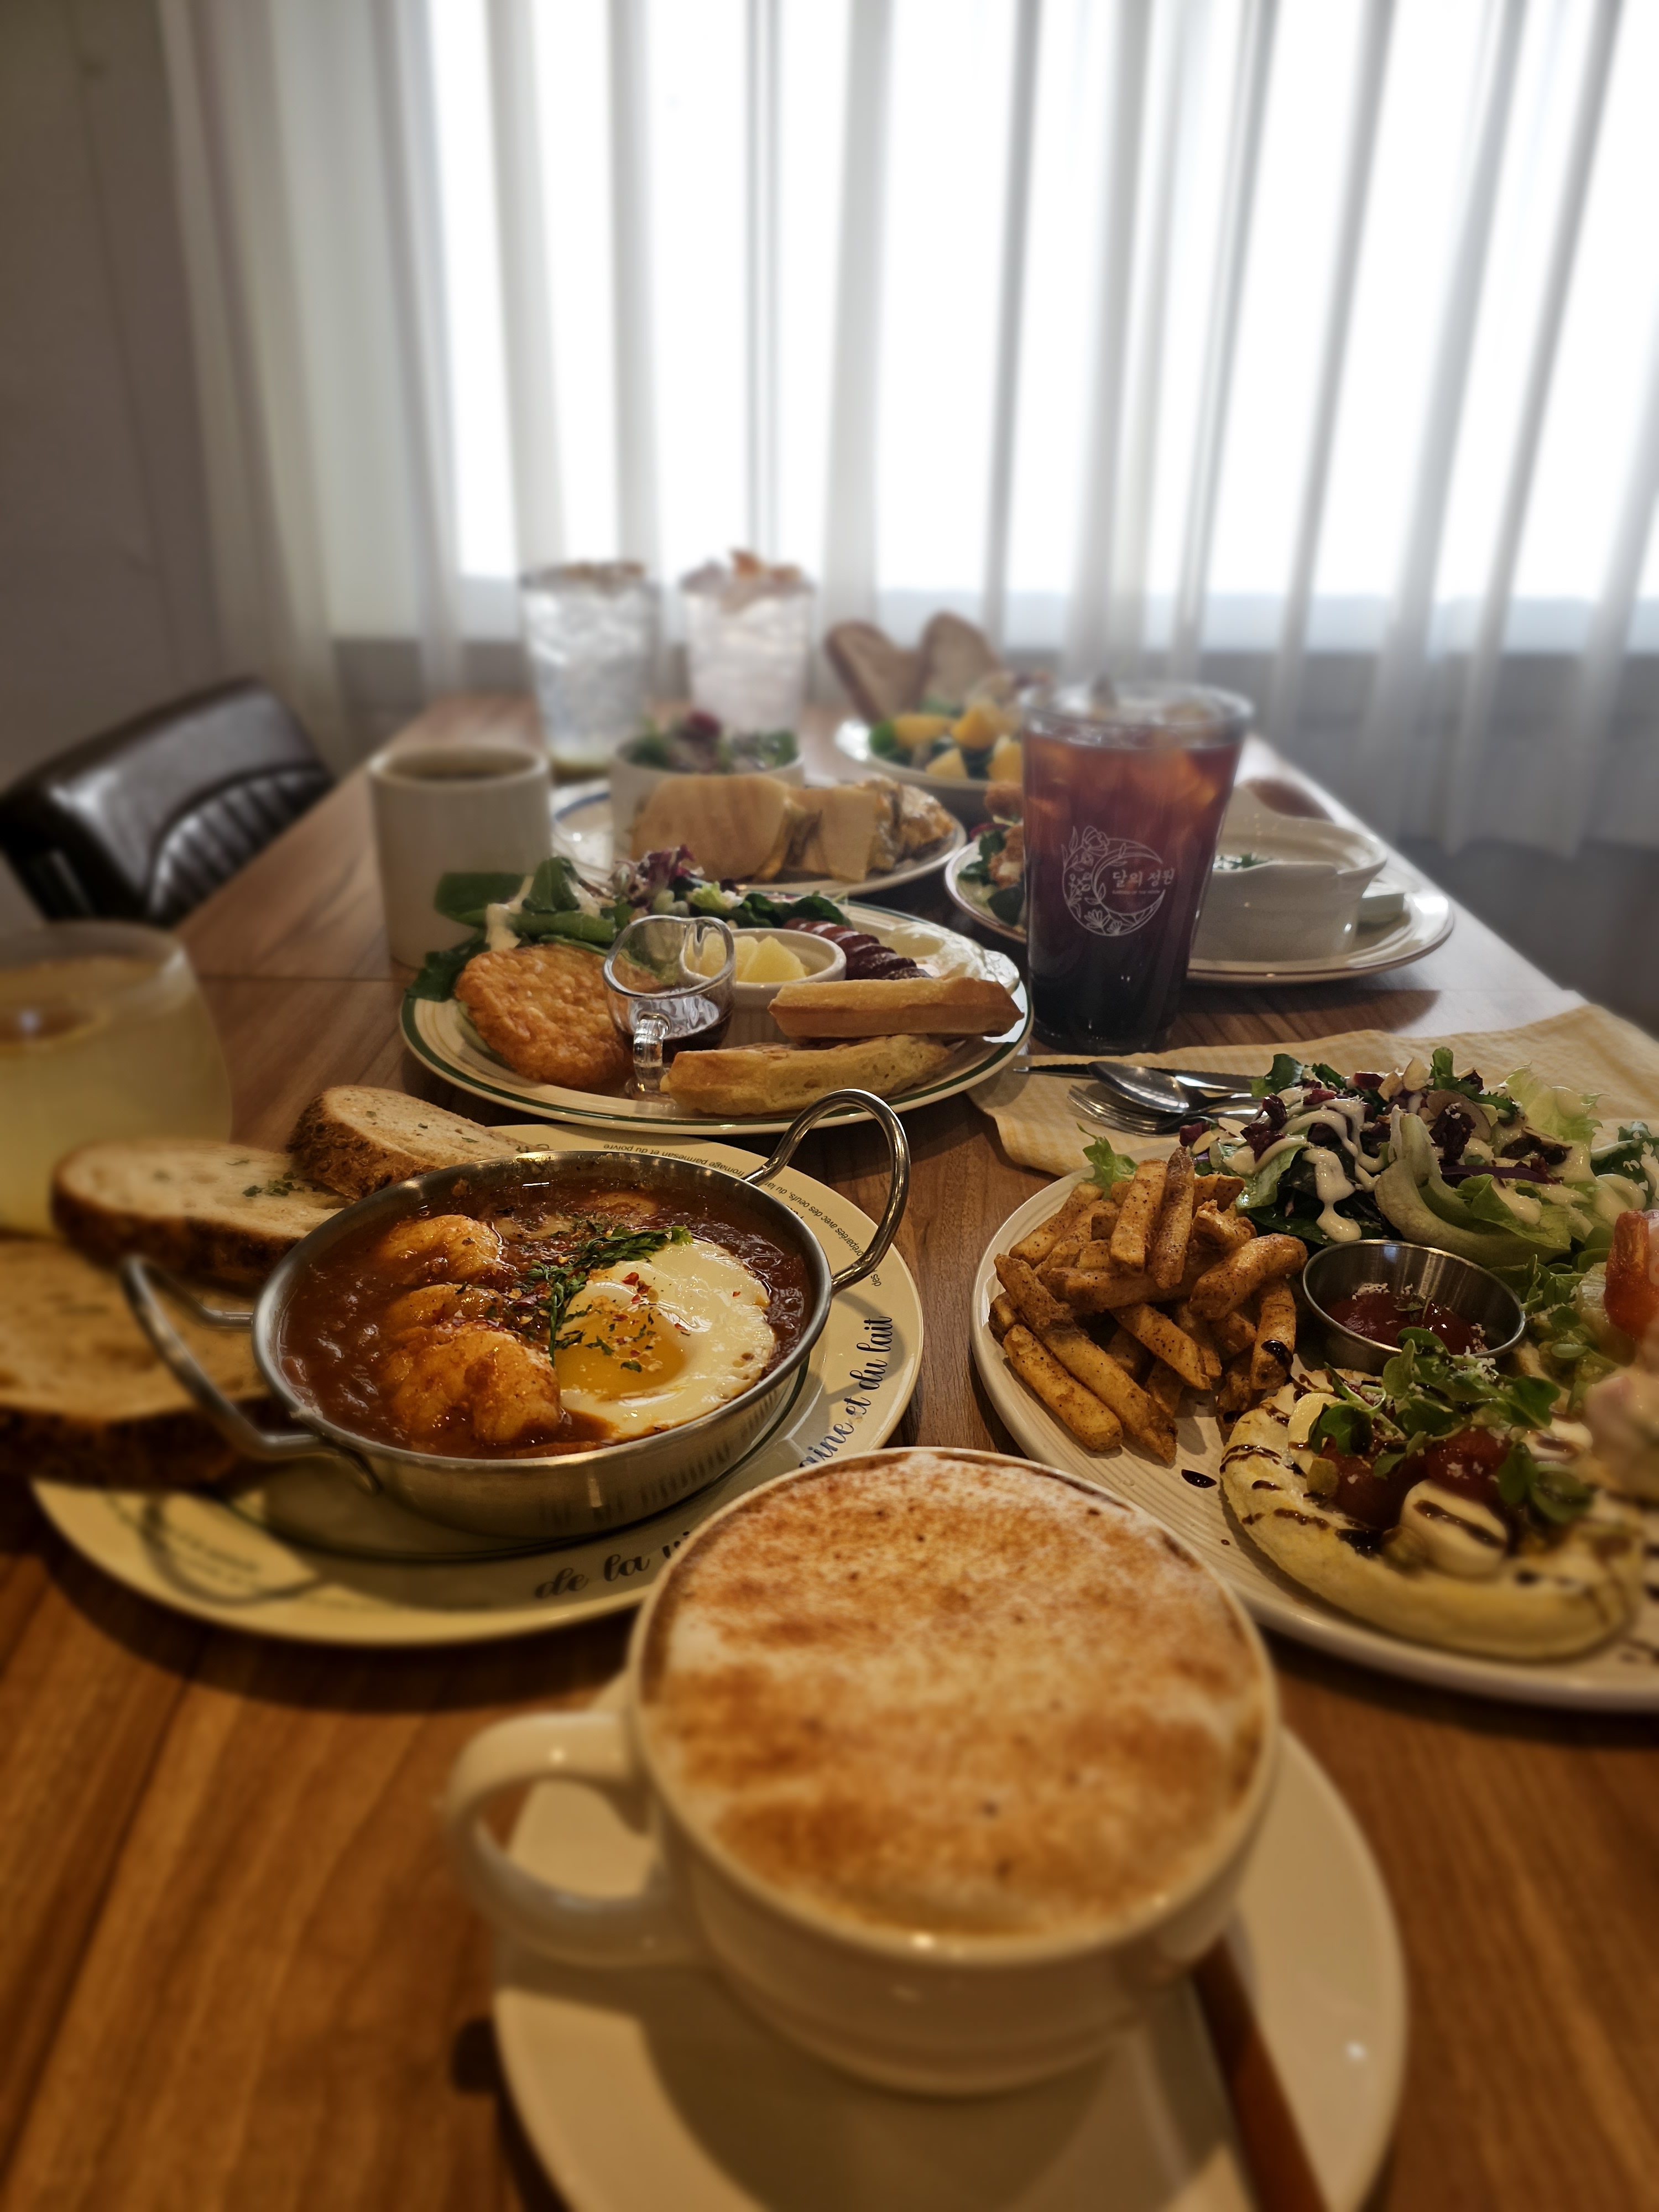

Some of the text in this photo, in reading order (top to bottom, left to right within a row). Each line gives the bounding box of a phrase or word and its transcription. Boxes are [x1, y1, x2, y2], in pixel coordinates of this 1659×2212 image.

[1112, 867, 1175, 888] 달의 정원
[662, 1152, 708, 1165] parmesan
[708, 1162, 745, 1177] fromage
[789, 1192, 810, 1208] oeufs,
[808, 1206, 823, 1217] des
[821, 1215, 838, 1229] avec
[870, 1274, 881, 1287] des
[857, 1316, 893, 1352] lait
[849, 1359, 888, 1390] du
[843, 1397, 872, 1415] et
[535, 1554, 650, 1599] de la
